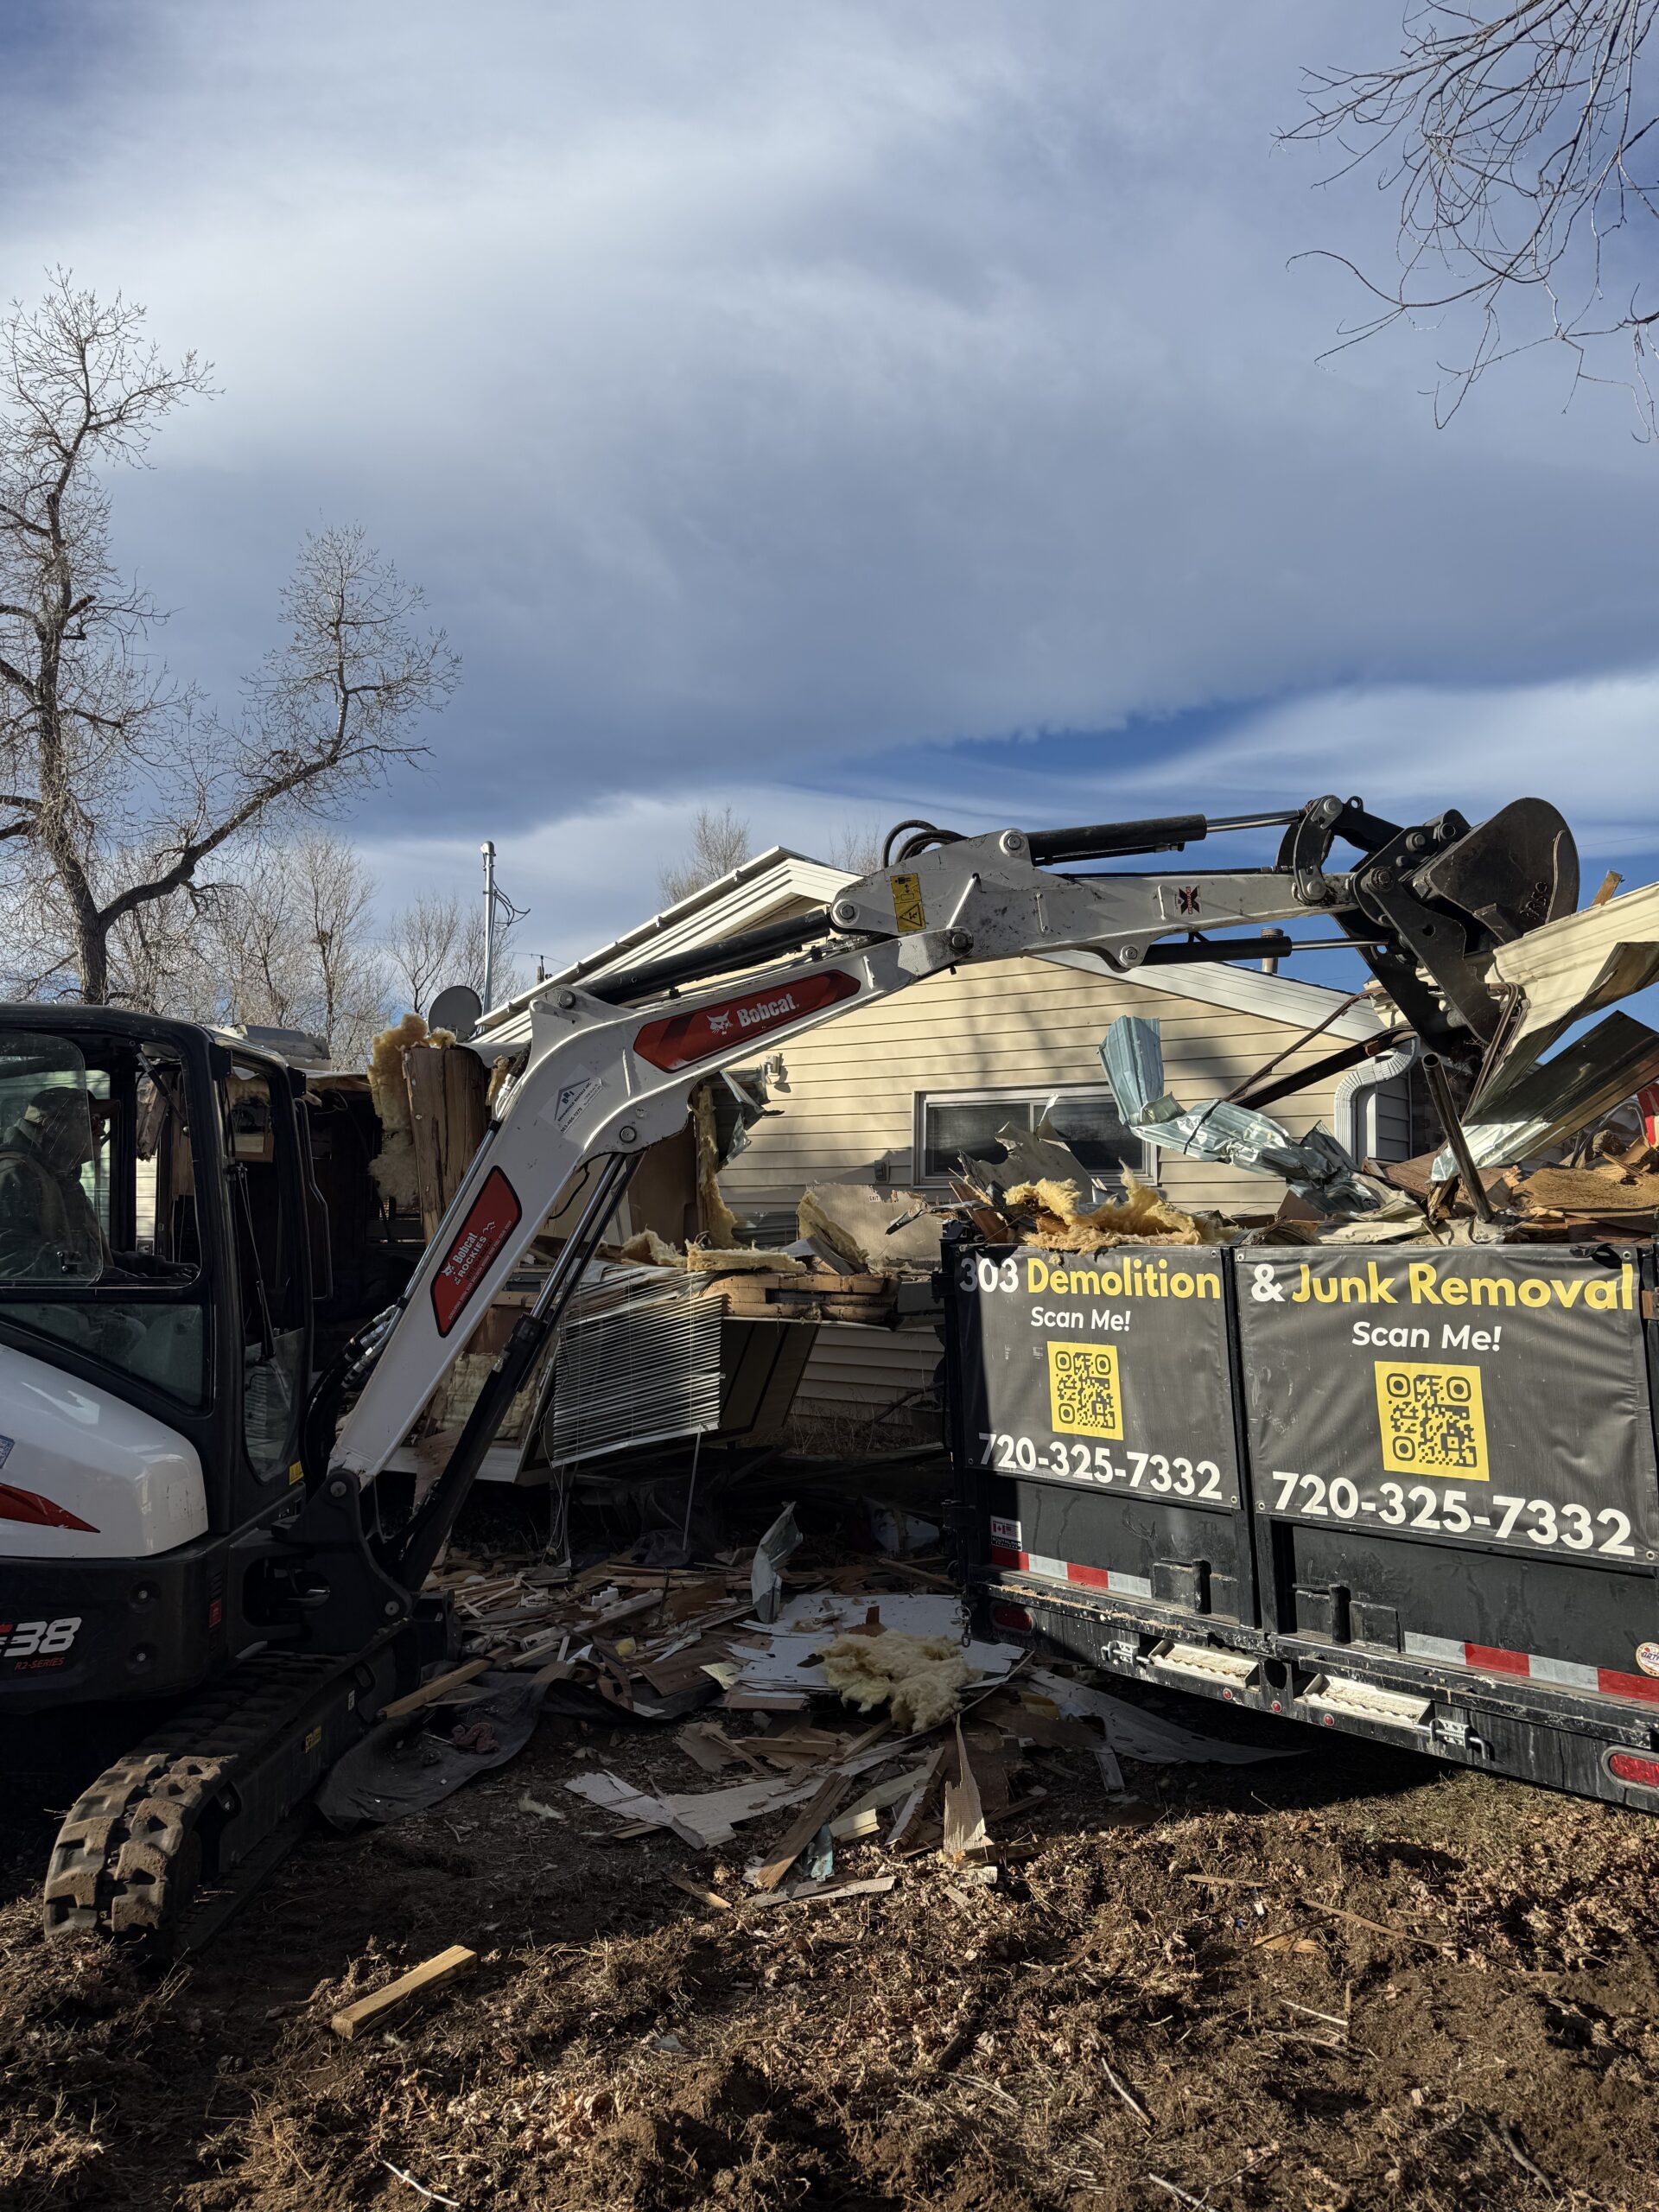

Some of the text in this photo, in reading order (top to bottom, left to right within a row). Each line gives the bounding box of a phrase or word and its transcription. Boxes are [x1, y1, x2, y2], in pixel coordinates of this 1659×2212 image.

[736, 993, 797, 1027] Bobcat
[562, 1090, 575, 1104] BRI
[453, 1232, 478, 1264] Bobcat
[457, 1235, 487, 1278] ROCKIES
[959, 1256, 1221, 1300] 303 Demolition
[1250, 1262, 1634, 1311] & Junk Removal
[1030, 1306, 1131, 1332] Scan Me!
[1351, 1321, 1502, 1351] Scan Me!
[978, 1432, 1223, 1501] 720-325-7332
[1272, 1471, 1636, 1557] 720-325-7332
[15, 1657, 66, 1670] R2-SERIES
